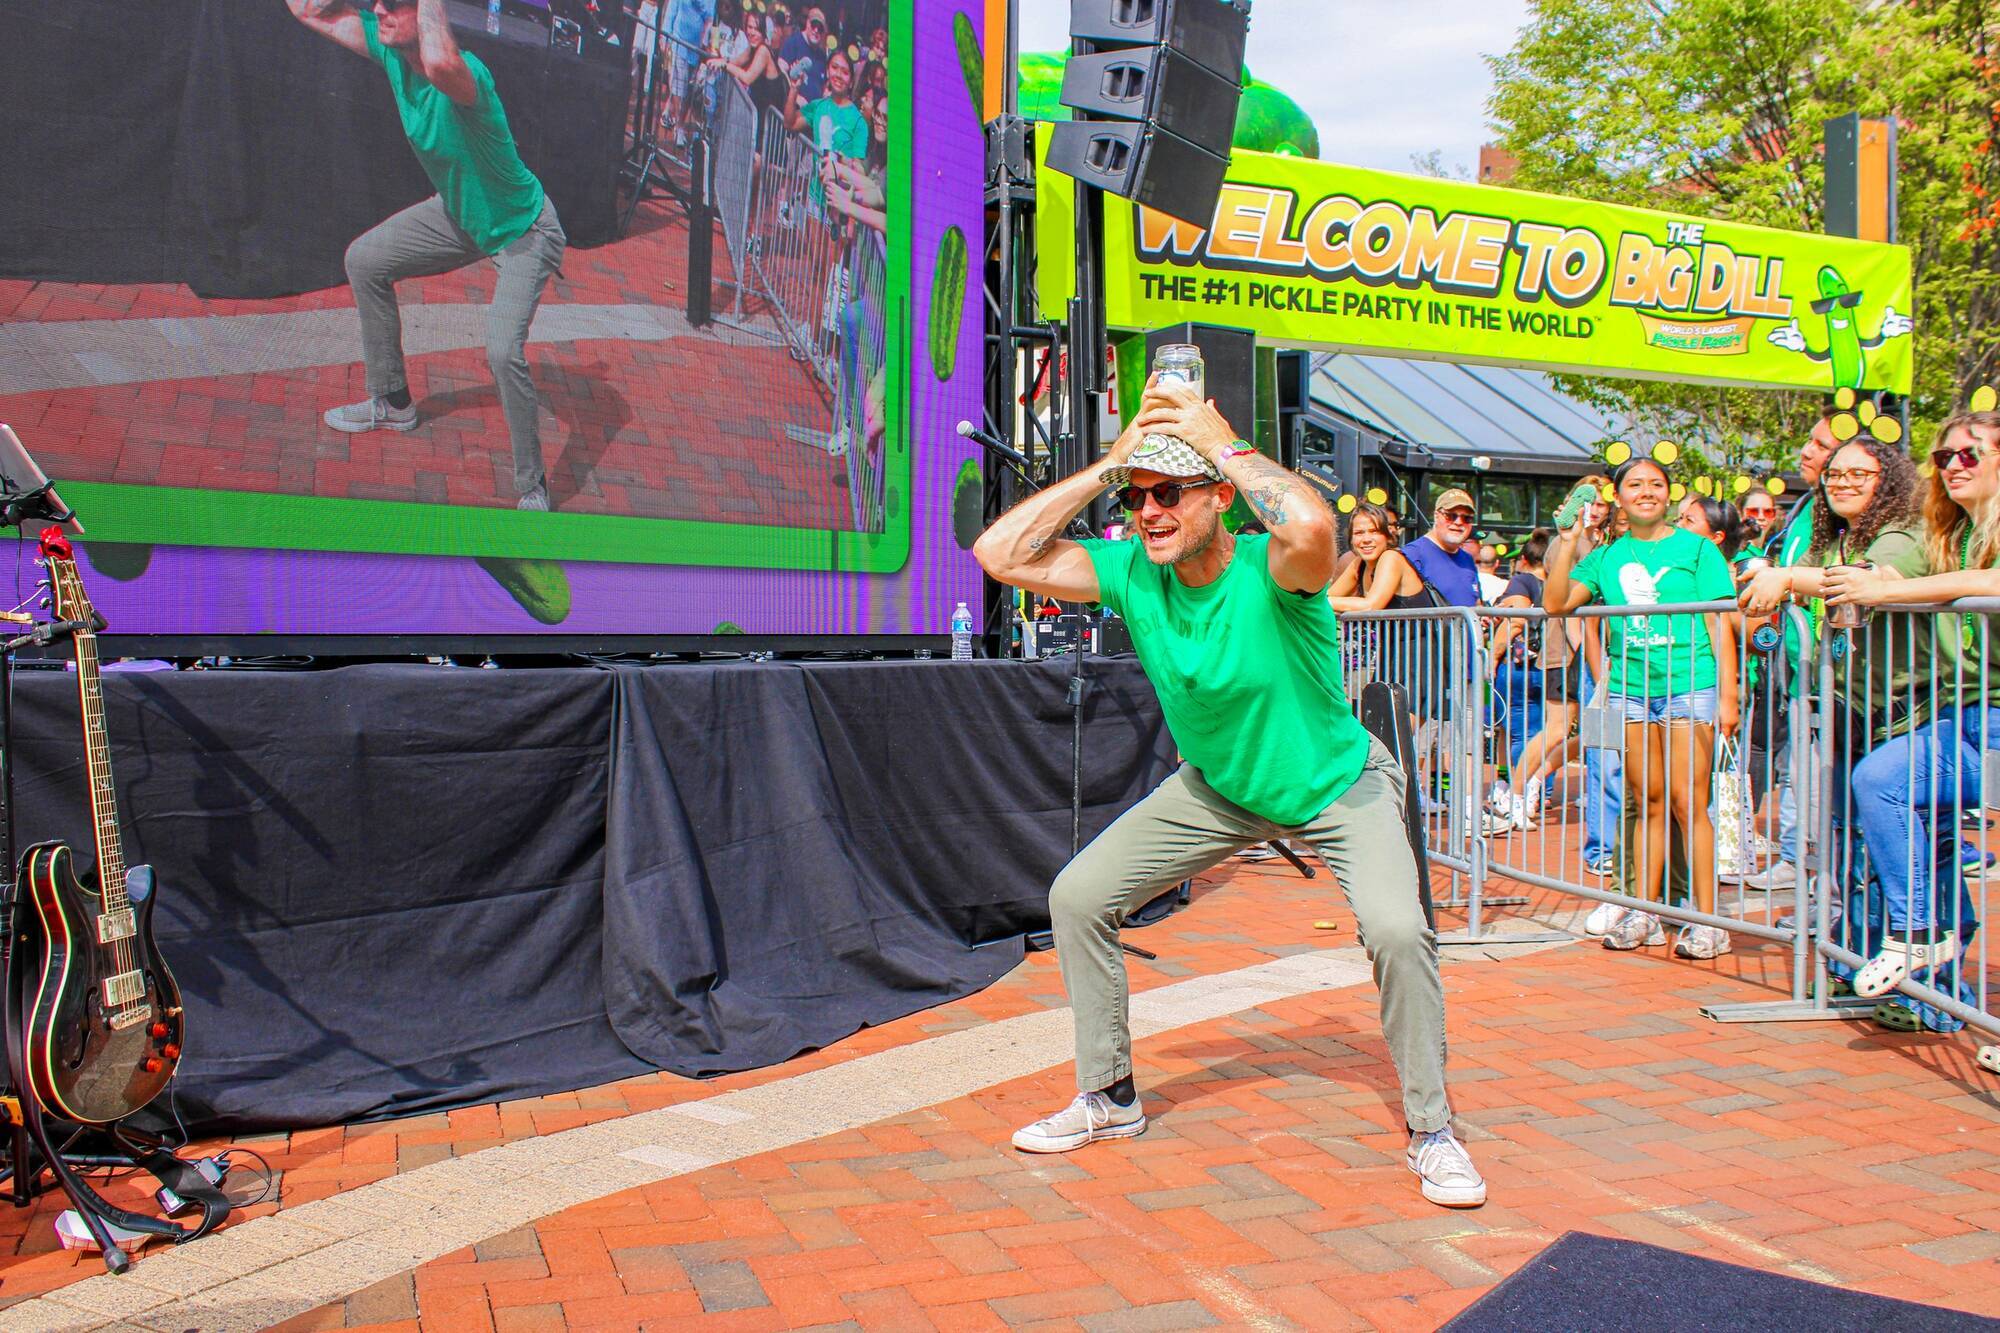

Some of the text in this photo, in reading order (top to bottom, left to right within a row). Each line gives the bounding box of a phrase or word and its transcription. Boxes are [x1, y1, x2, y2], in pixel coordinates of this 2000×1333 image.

[1516, 222, 1606, 300] TO
[1667, 221, 1705, 245] THE
[1139, 273, 1197, 302] THE
[1201, 278, 1240, 306] #1
[1249, 282, 1338, 317] PICKLE
[1343, 292, 1422, 323] PARTY
[1428, 301, 1450, 327] IN
[1456, 304, 1501, 331] THE
[1611, 232, 1793, 318] BIG DILL
